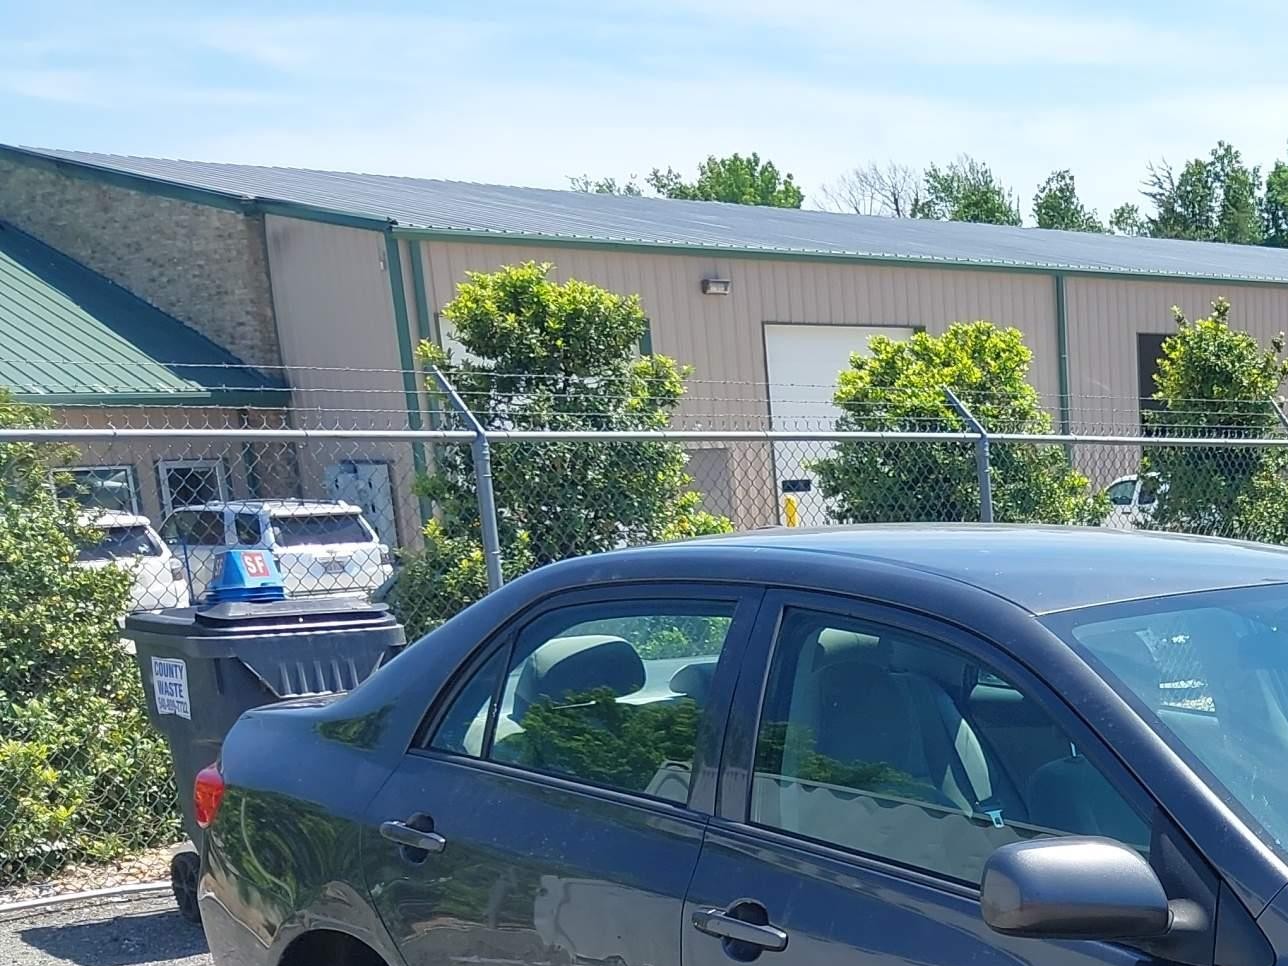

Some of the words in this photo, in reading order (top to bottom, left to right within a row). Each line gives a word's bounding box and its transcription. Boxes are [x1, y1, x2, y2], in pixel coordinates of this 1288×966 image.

[243, 555, 266, 574] SF
[154, 661, 184, 679] COUNTY
[157, 680, 184, 698] WASTE
